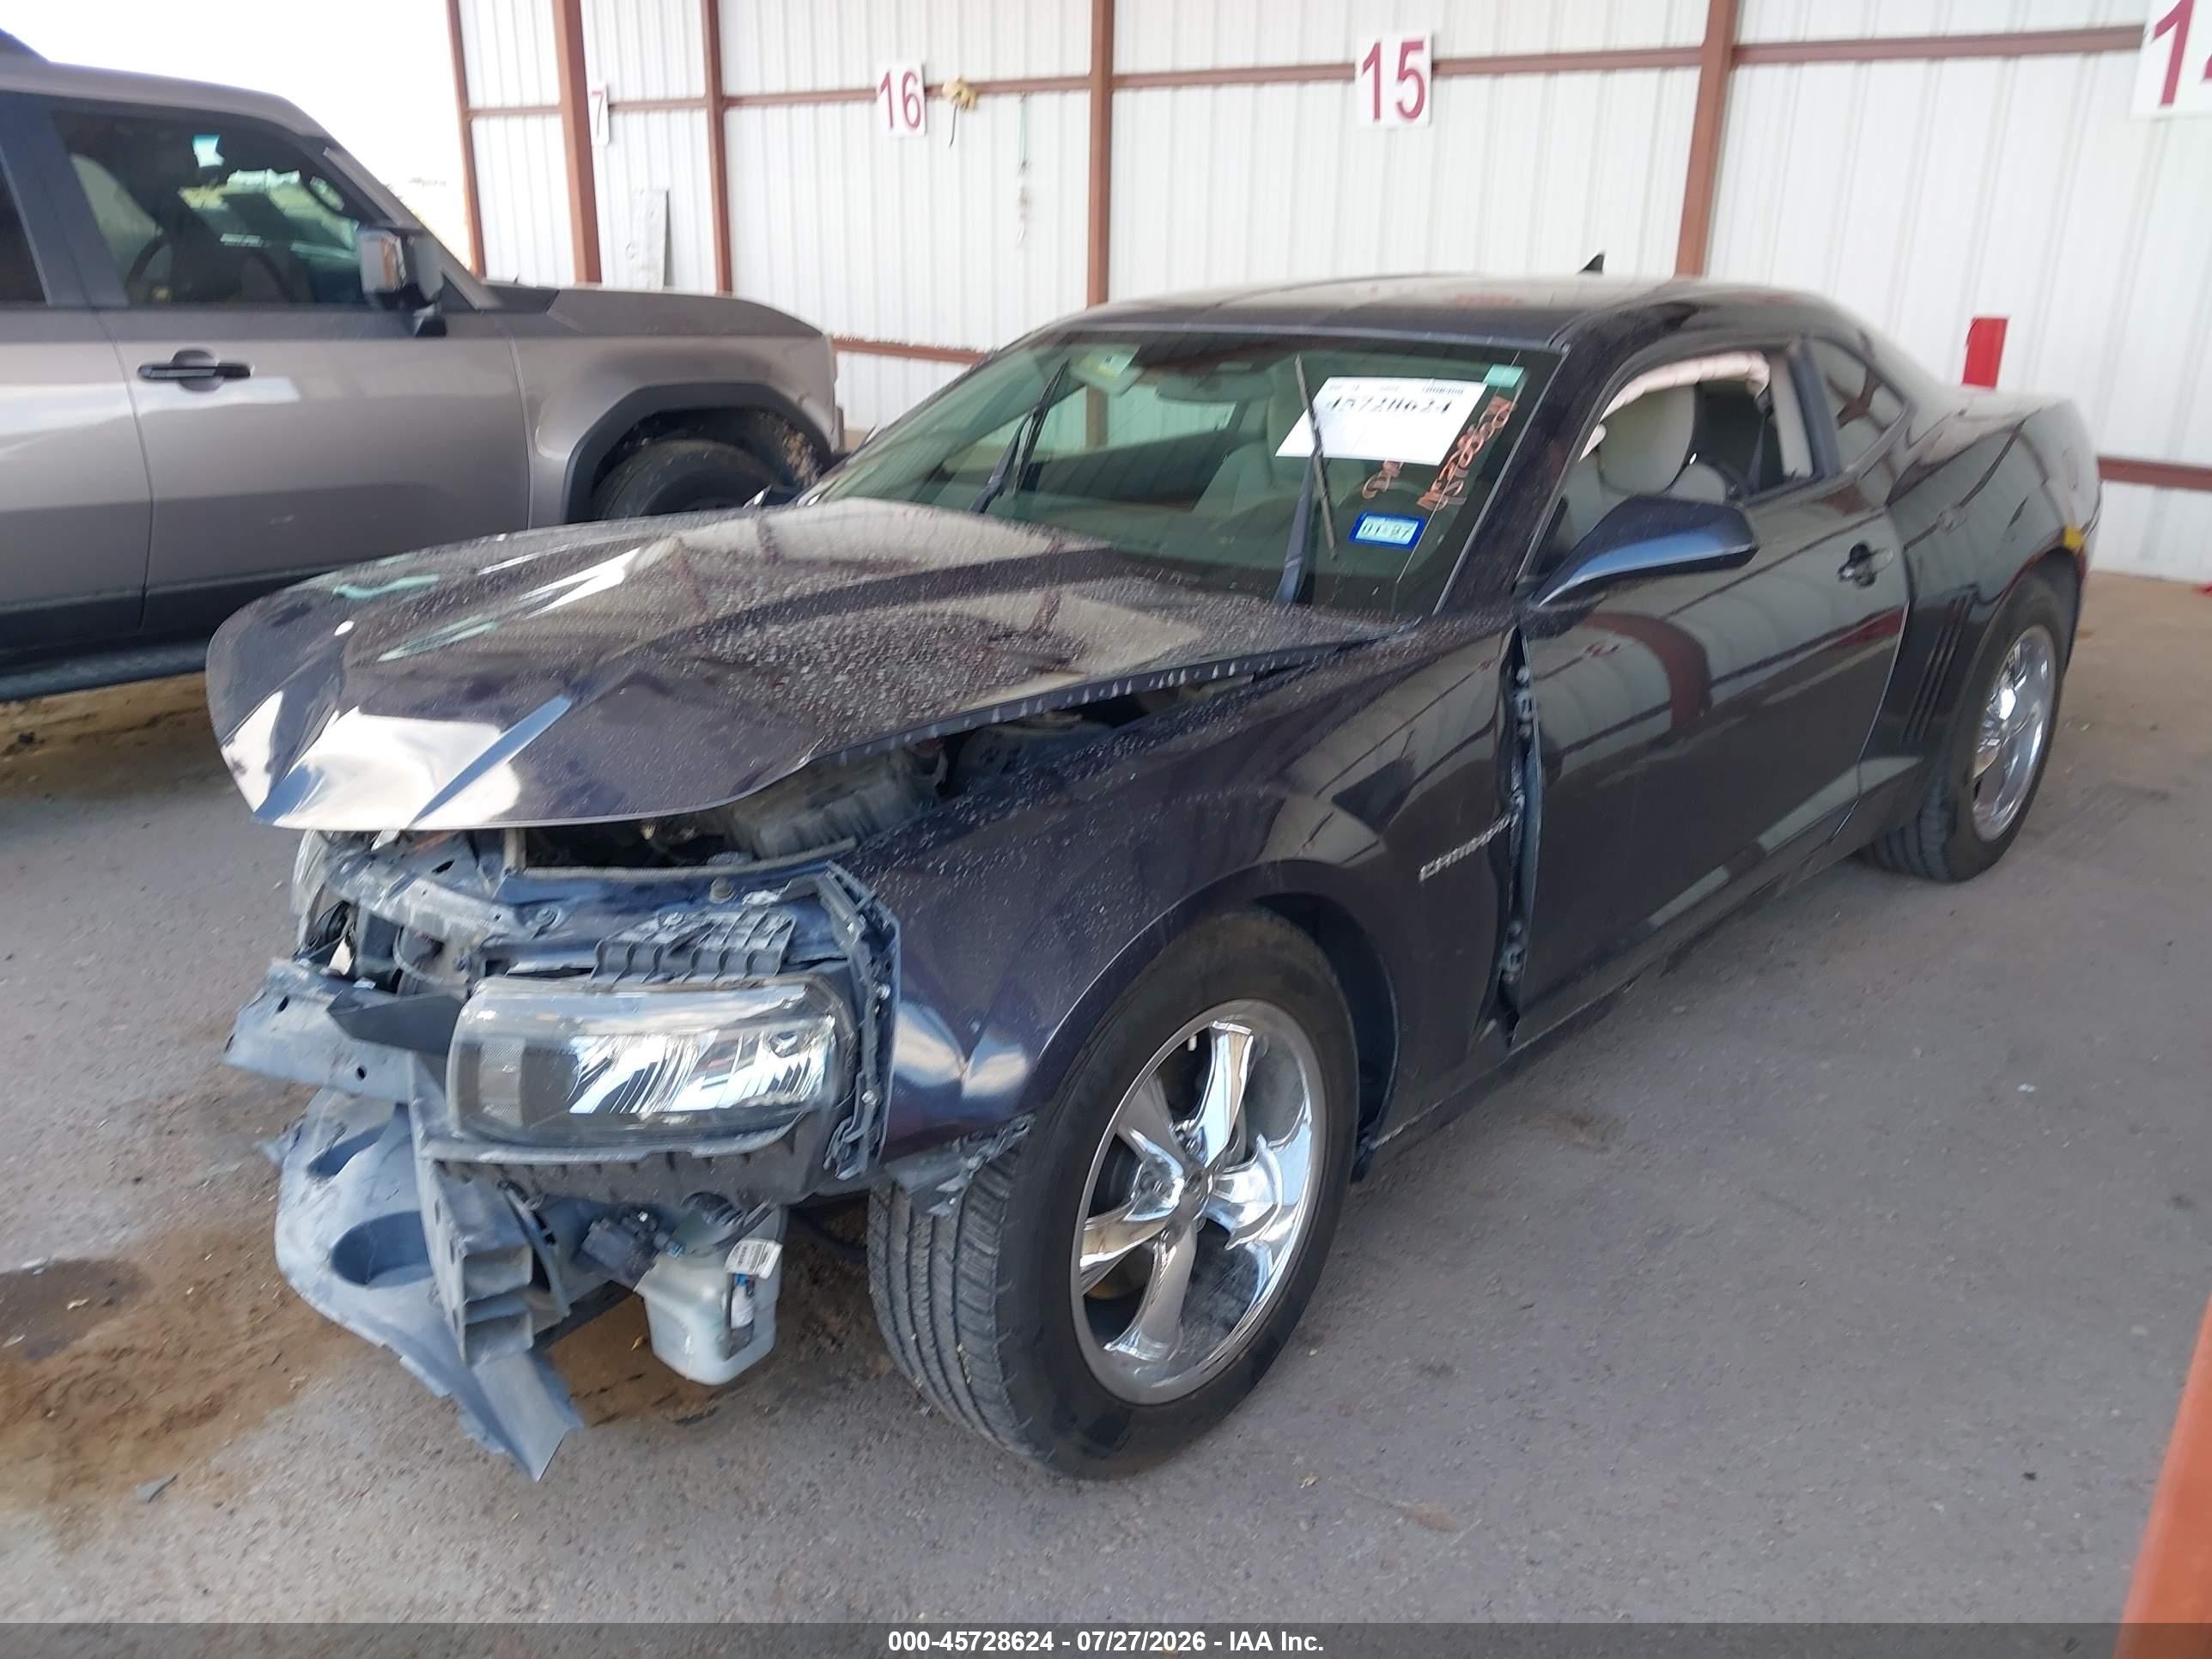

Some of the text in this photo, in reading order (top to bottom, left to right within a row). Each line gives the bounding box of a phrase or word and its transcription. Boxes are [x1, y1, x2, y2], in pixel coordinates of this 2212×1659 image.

[1361, 40, 1425, 121] 15
[2151, 0, 2212, 108] 1
[878, 70, 922, 131] 16
